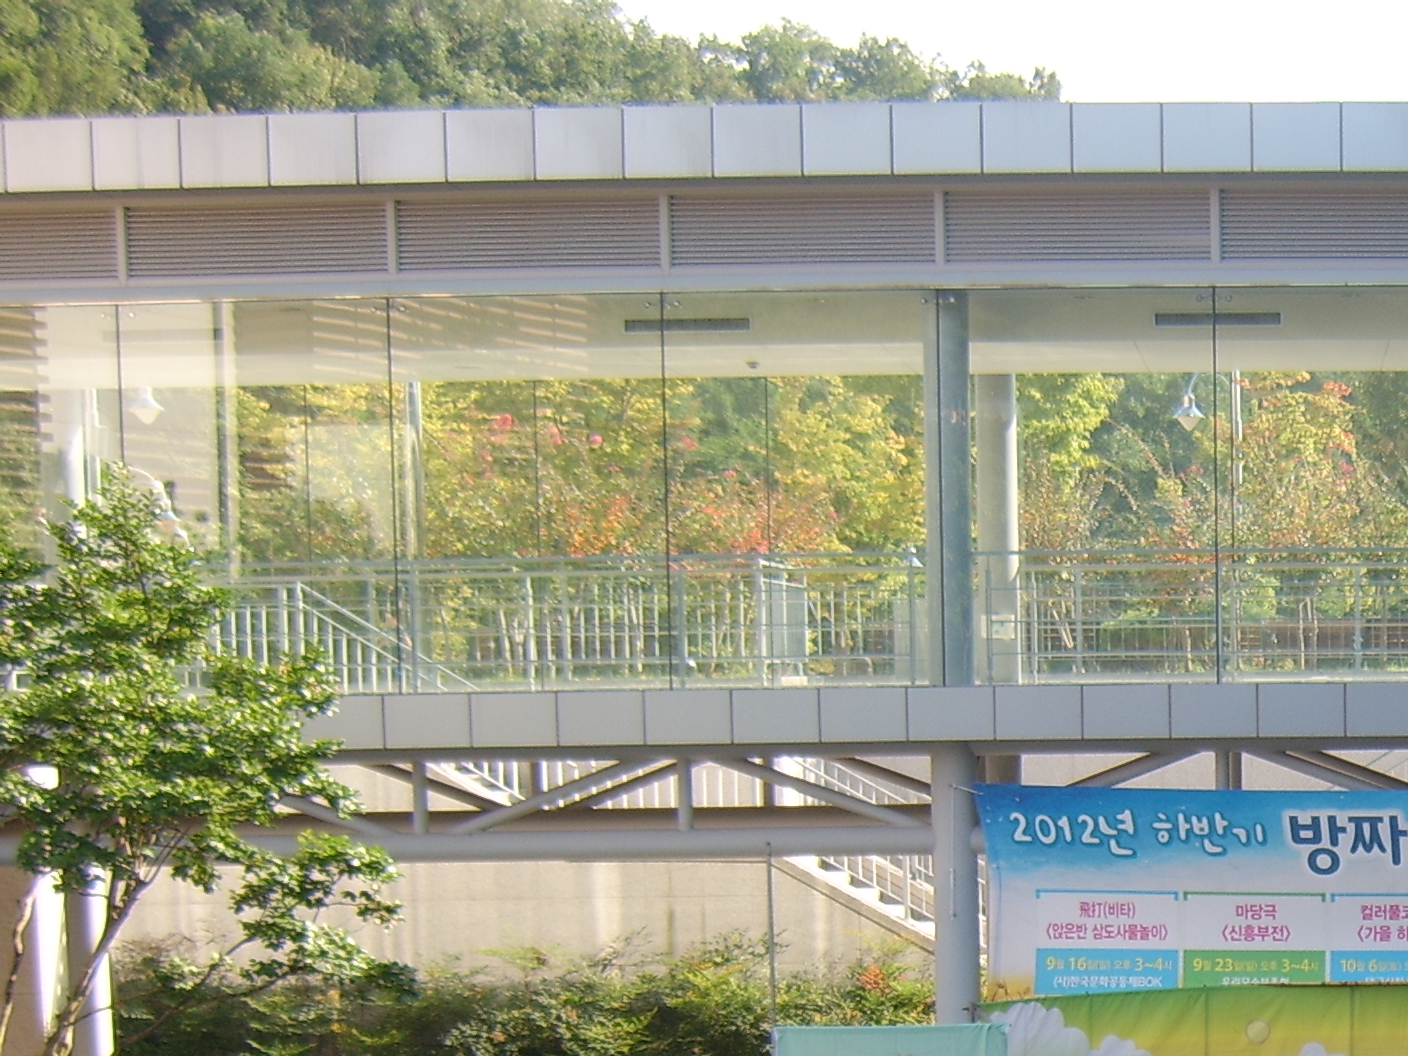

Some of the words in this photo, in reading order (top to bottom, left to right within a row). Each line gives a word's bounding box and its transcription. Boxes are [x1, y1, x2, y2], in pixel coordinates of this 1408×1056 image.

[1008, 808, 1137, 857] 2012년
[1151, 811, 1265, 855] 하반기
[1235, 904, 1278, 920] 마당극
